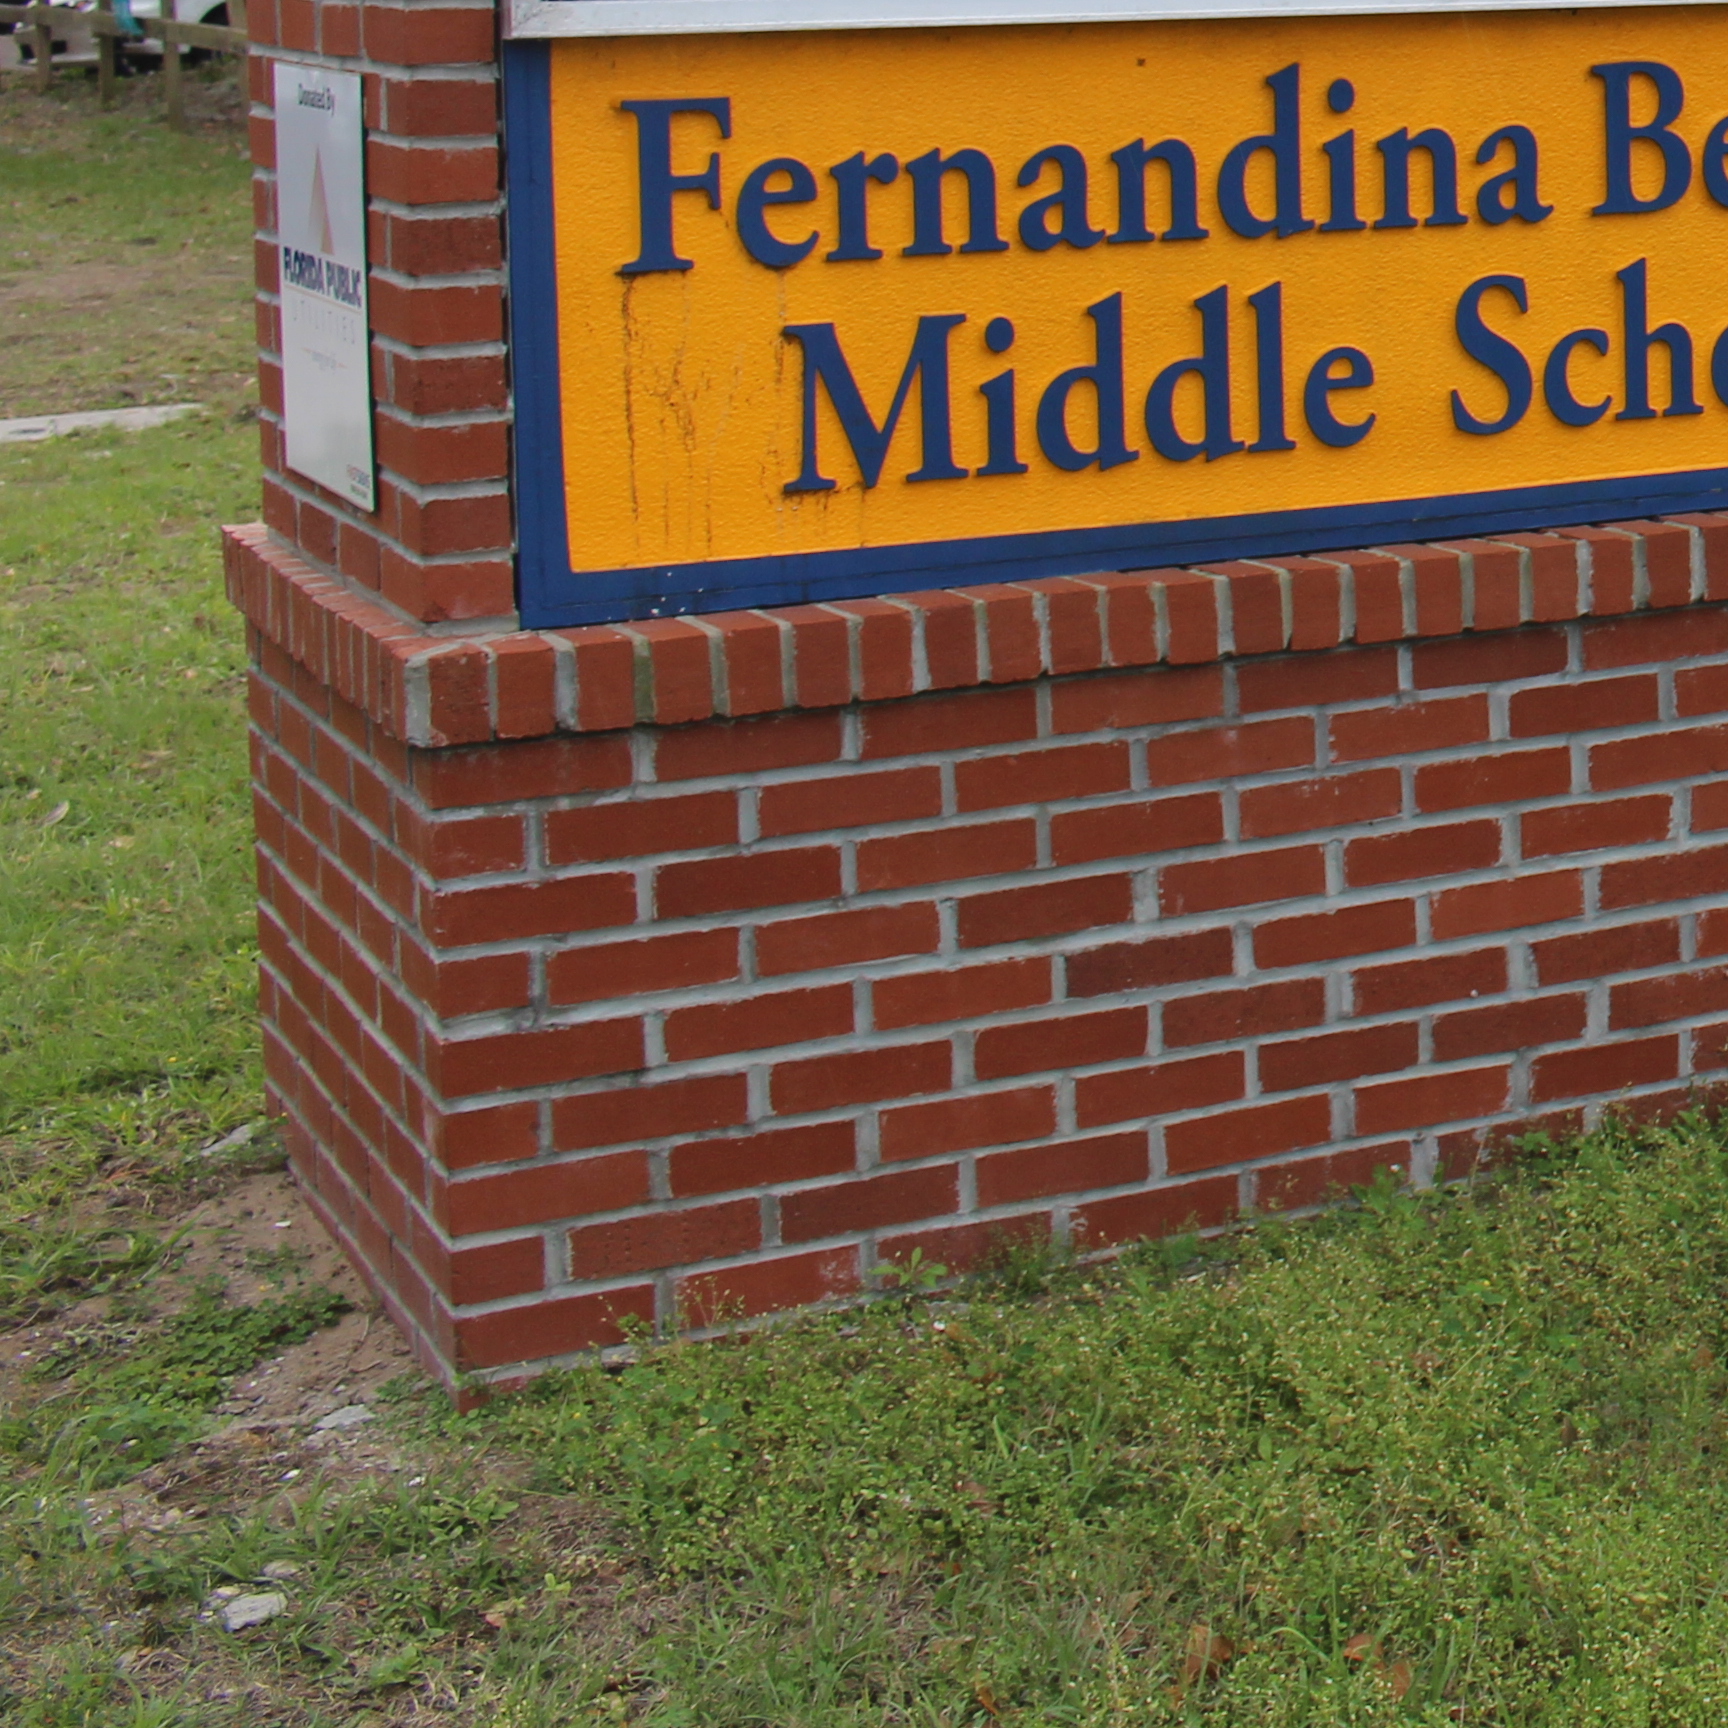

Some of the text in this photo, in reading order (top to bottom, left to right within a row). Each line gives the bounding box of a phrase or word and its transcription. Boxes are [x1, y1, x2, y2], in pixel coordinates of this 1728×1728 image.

[297, 83, 336, 118] Donated By
[615, 61, 1553, 276] Fernandina
[283, 246, 362, 309] FLORIDA PUBLIC
[781, 281, 1376, 494] Middle
